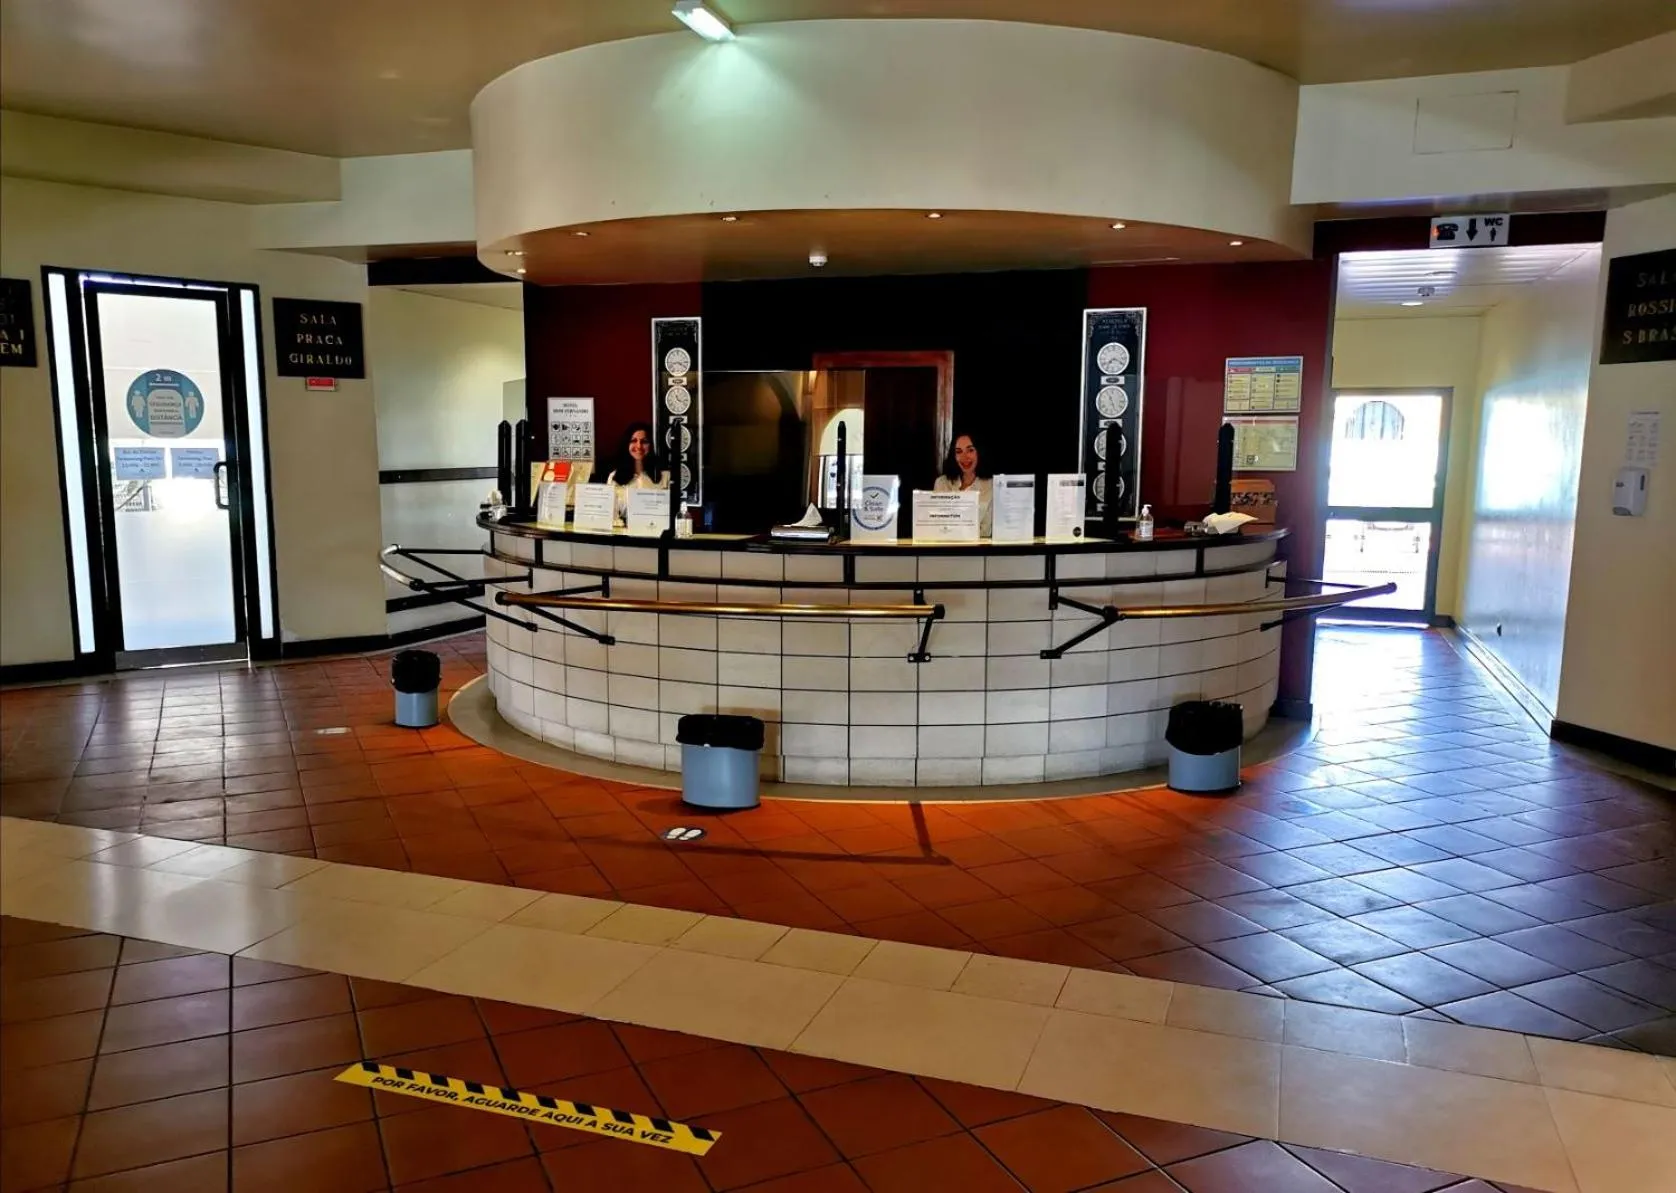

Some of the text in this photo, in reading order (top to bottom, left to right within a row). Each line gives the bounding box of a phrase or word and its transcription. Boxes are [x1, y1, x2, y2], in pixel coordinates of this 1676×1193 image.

[1484, 217, 1503, 227] WC
[300, 312, 336, 325] SALA
[288, 352, 352, 365] GIRALDO
[155, 373, 161, 381] 2
[372, 1076, 673, 1144] POR FAVOR, AGUARDE AQUI A SUA VEZ
